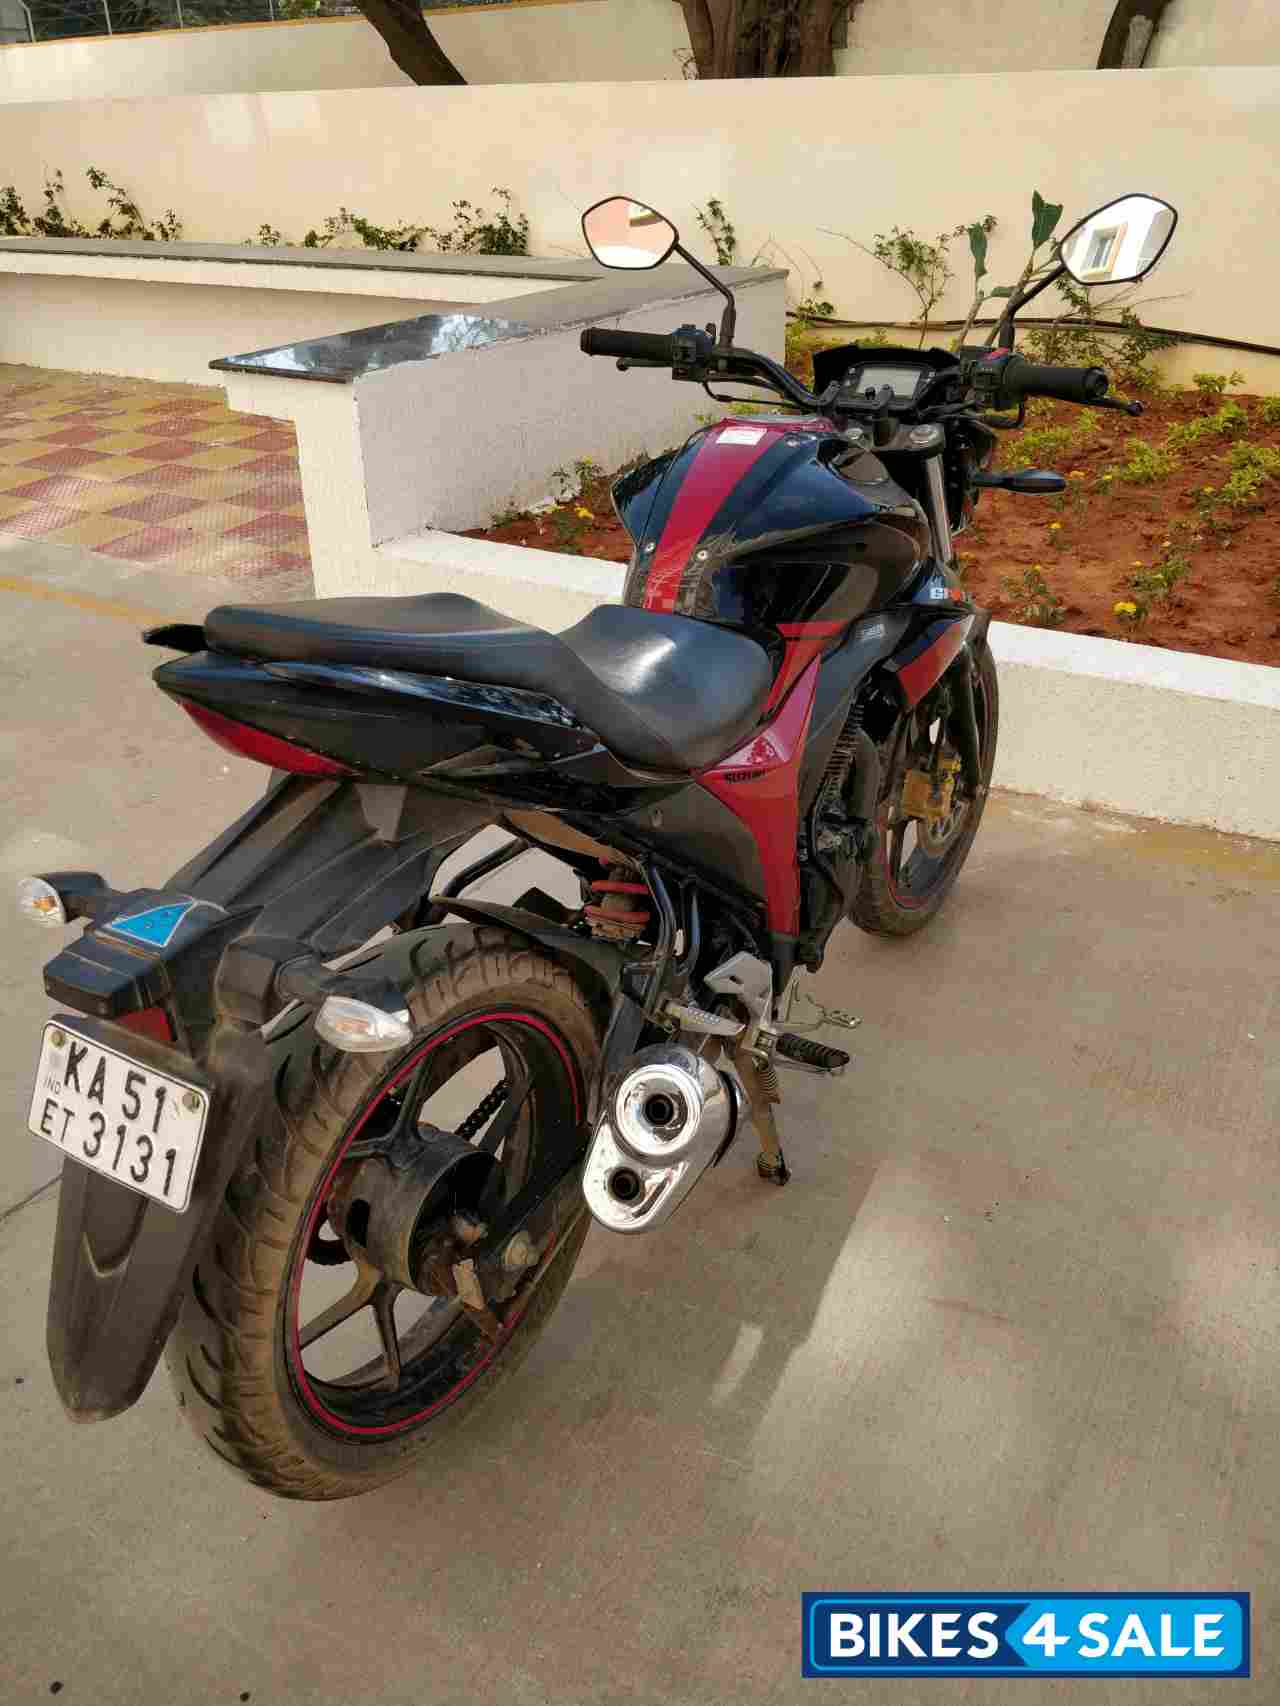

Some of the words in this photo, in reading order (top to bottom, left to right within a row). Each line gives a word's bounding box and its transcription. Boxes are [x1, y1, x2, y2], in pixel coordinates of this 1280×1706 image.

[63, 1040, 107, 1106] KA
[121, 1070, 167, 1133] 51
[39, 1097, 76, 1142] ET
[82, 1111, 177, 1196] 3131
